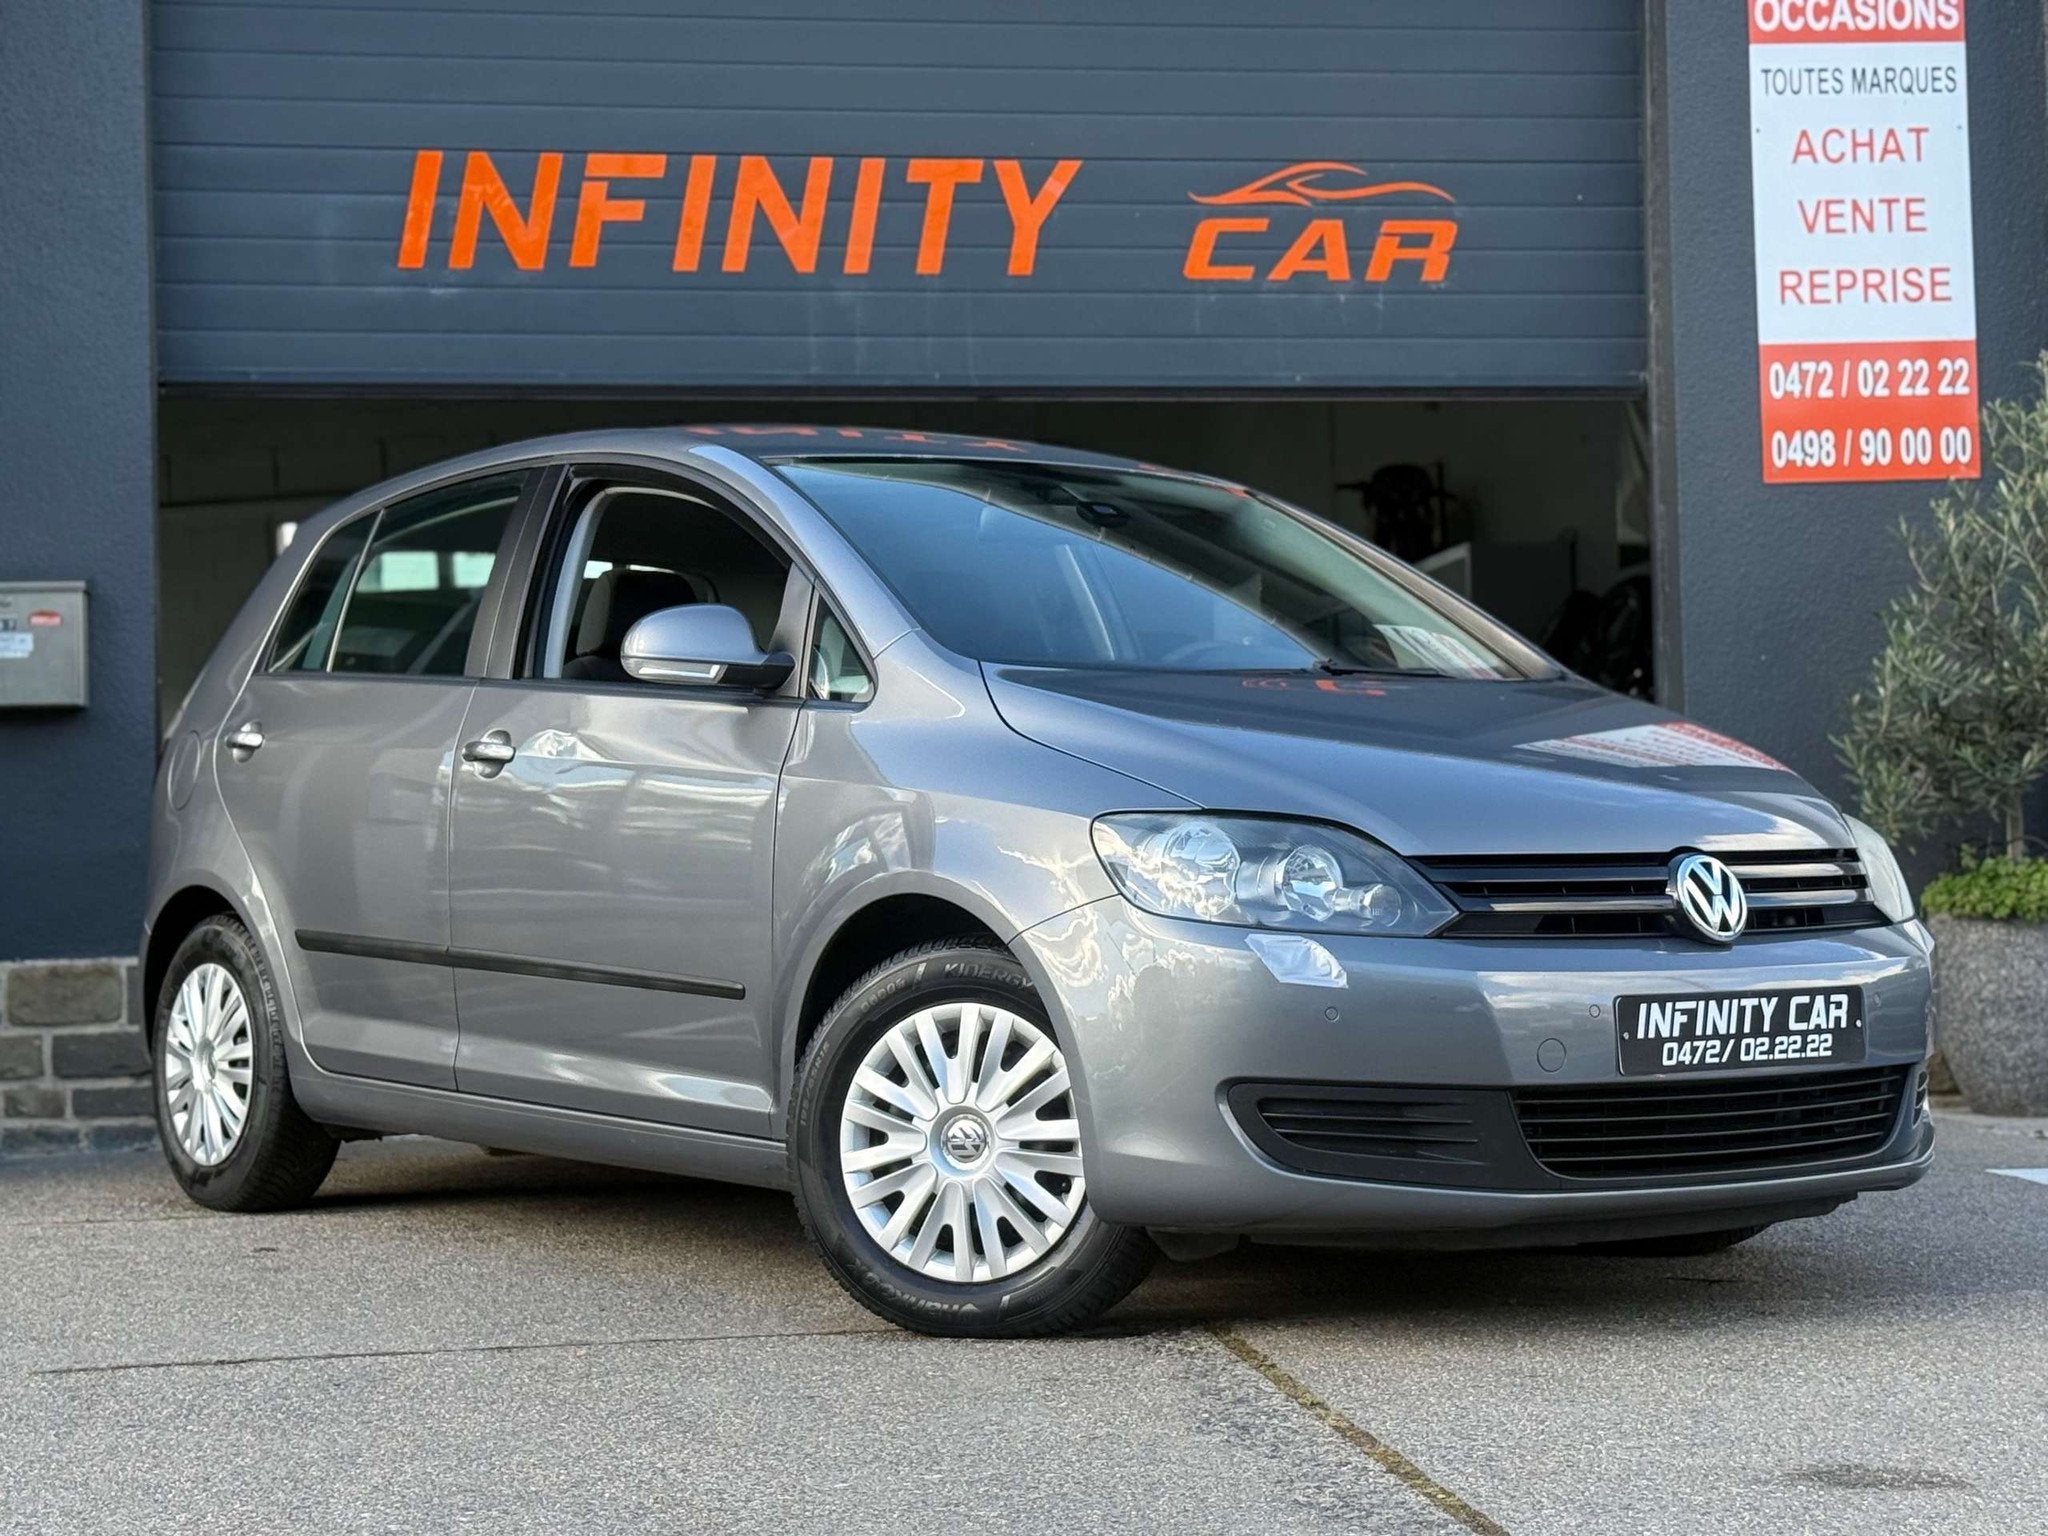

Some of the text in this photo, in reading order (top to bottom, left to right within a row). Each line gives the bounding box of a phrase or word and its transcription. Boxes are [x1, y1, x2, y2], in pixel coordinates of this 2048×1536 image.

[1754, 0, 1960, 32] OCCASIONS
[1761, 66, 1957, 95] TOUTES MARQUES
[1792, 127, 1929, 164] ACHAT
[397, 150, 1458, 282] INFINITY CAR
[1797, 197, 1927, 234] VENTE
[1779, 266, 1952, 305] REPRISE
[1769, 357, 1970, 400] 0472 / 02 22 22
[1771, 426, 1972, 469] 0498 / 90 00 00
[1637, 993, 1849, 1040] INFINITY CAR
[1739, 1033, 1833, 1062] 02.22.22
